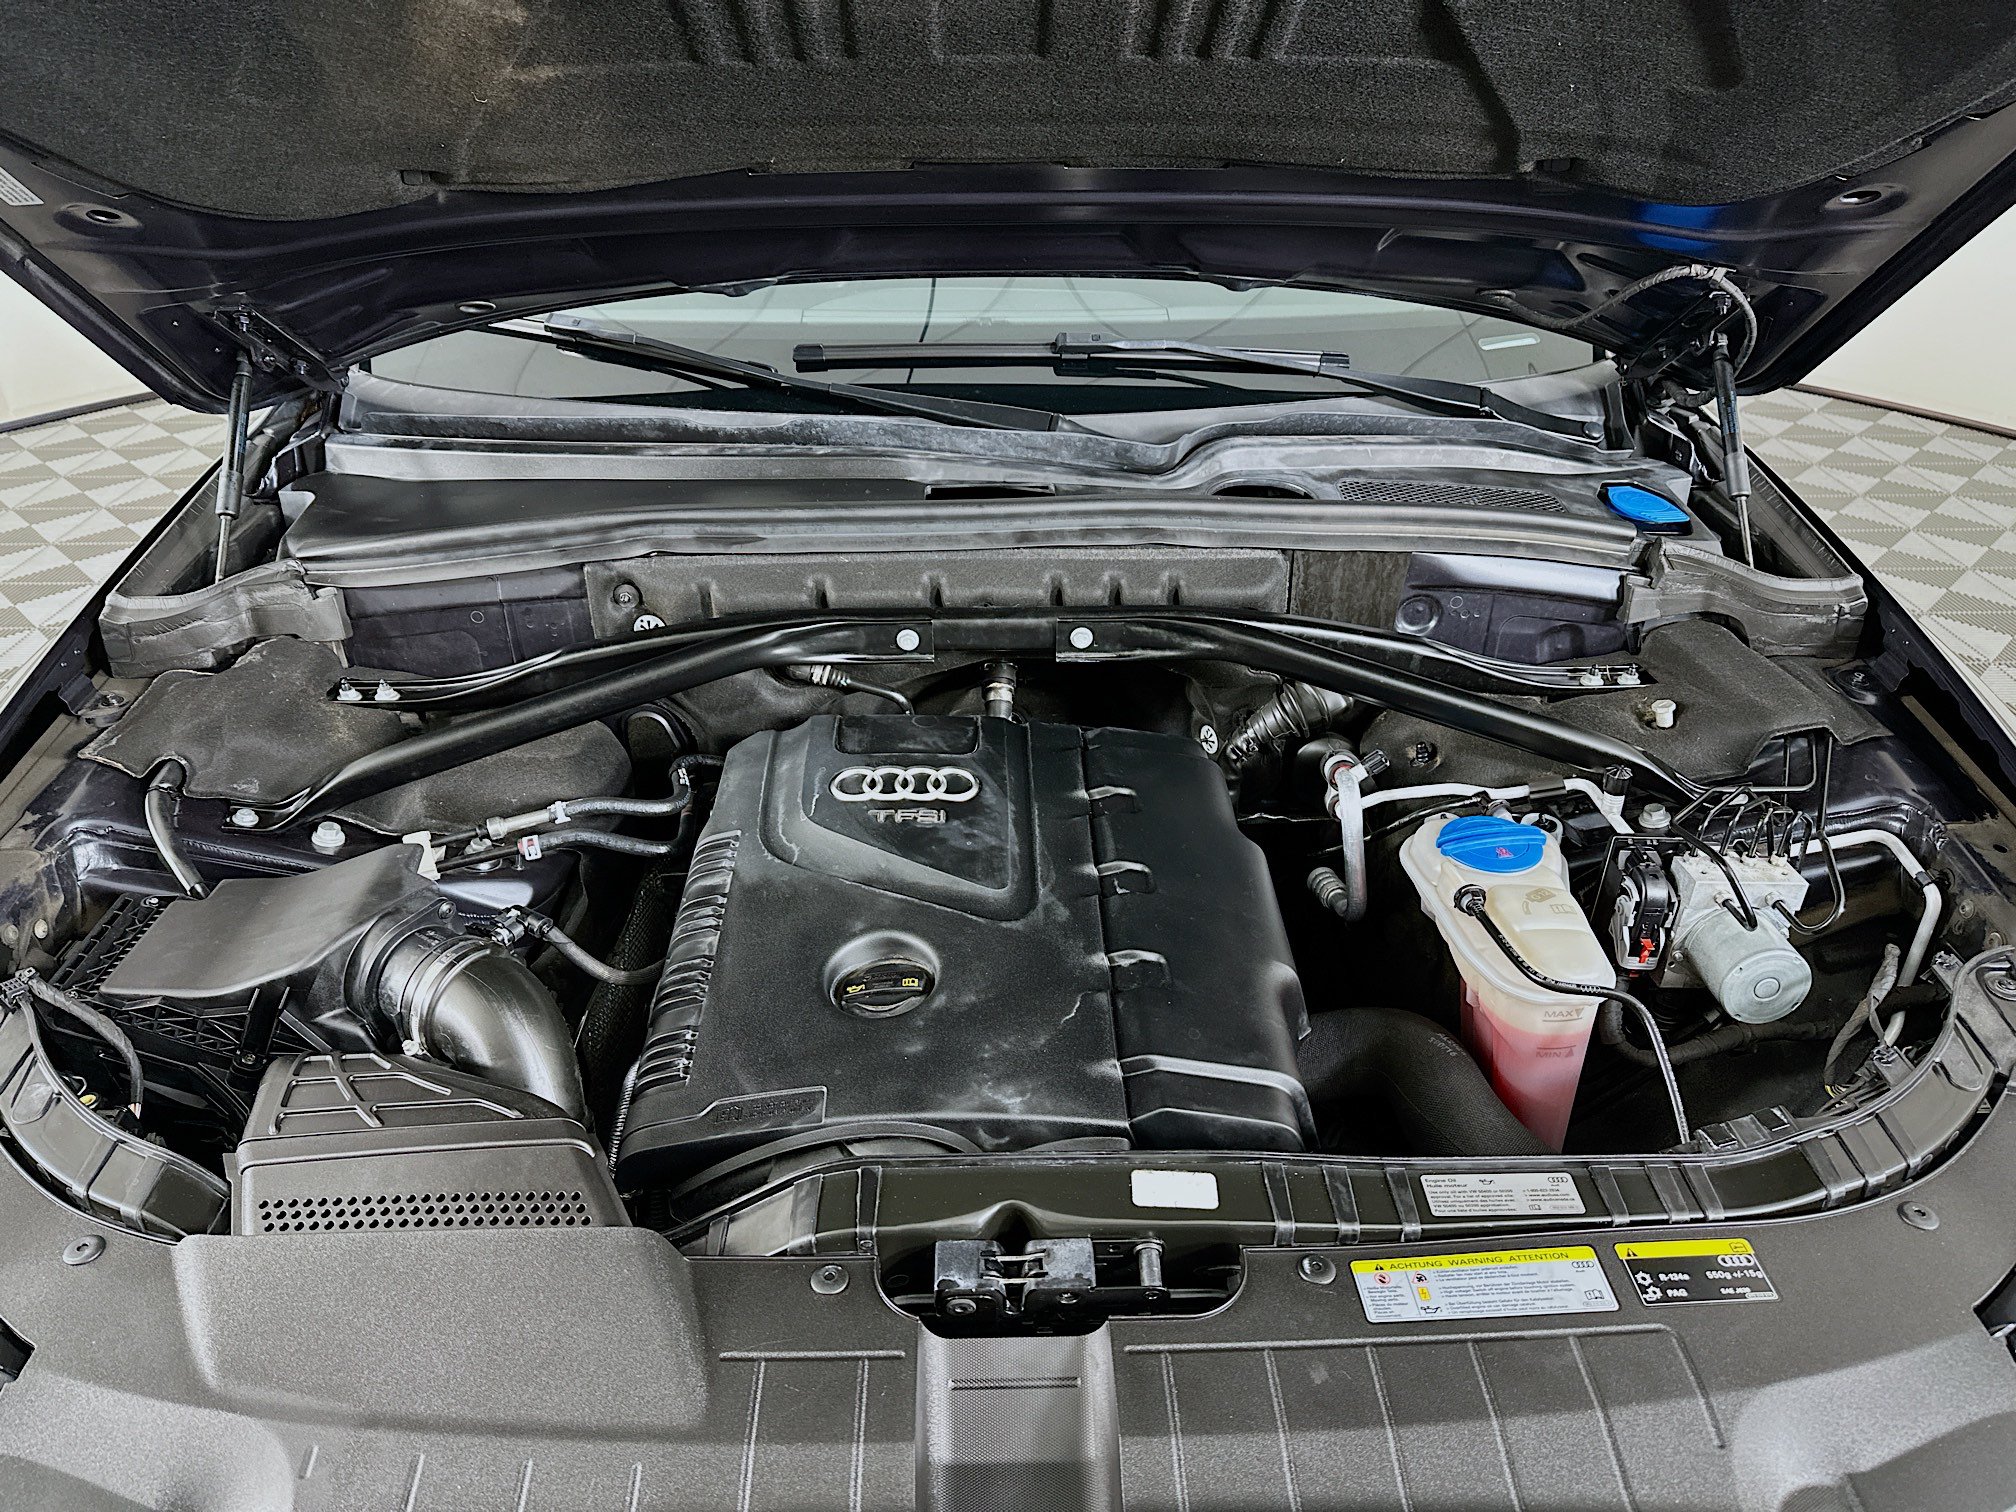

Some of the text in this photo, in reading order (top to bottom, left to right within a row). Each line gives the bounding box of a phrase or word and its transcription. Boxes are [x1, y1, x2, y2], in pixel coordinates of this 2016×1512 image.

[867, 808, 947, 826] TFSI
[1544, 1010, 1574, 1018] MAX
[1389, 1252, 1569, 1270] ACHTUNG WARNING ATTENTION
[1658, 1273, 1690, 1282] R-134a
[1666, 1288, 1688, 1298] PAG
